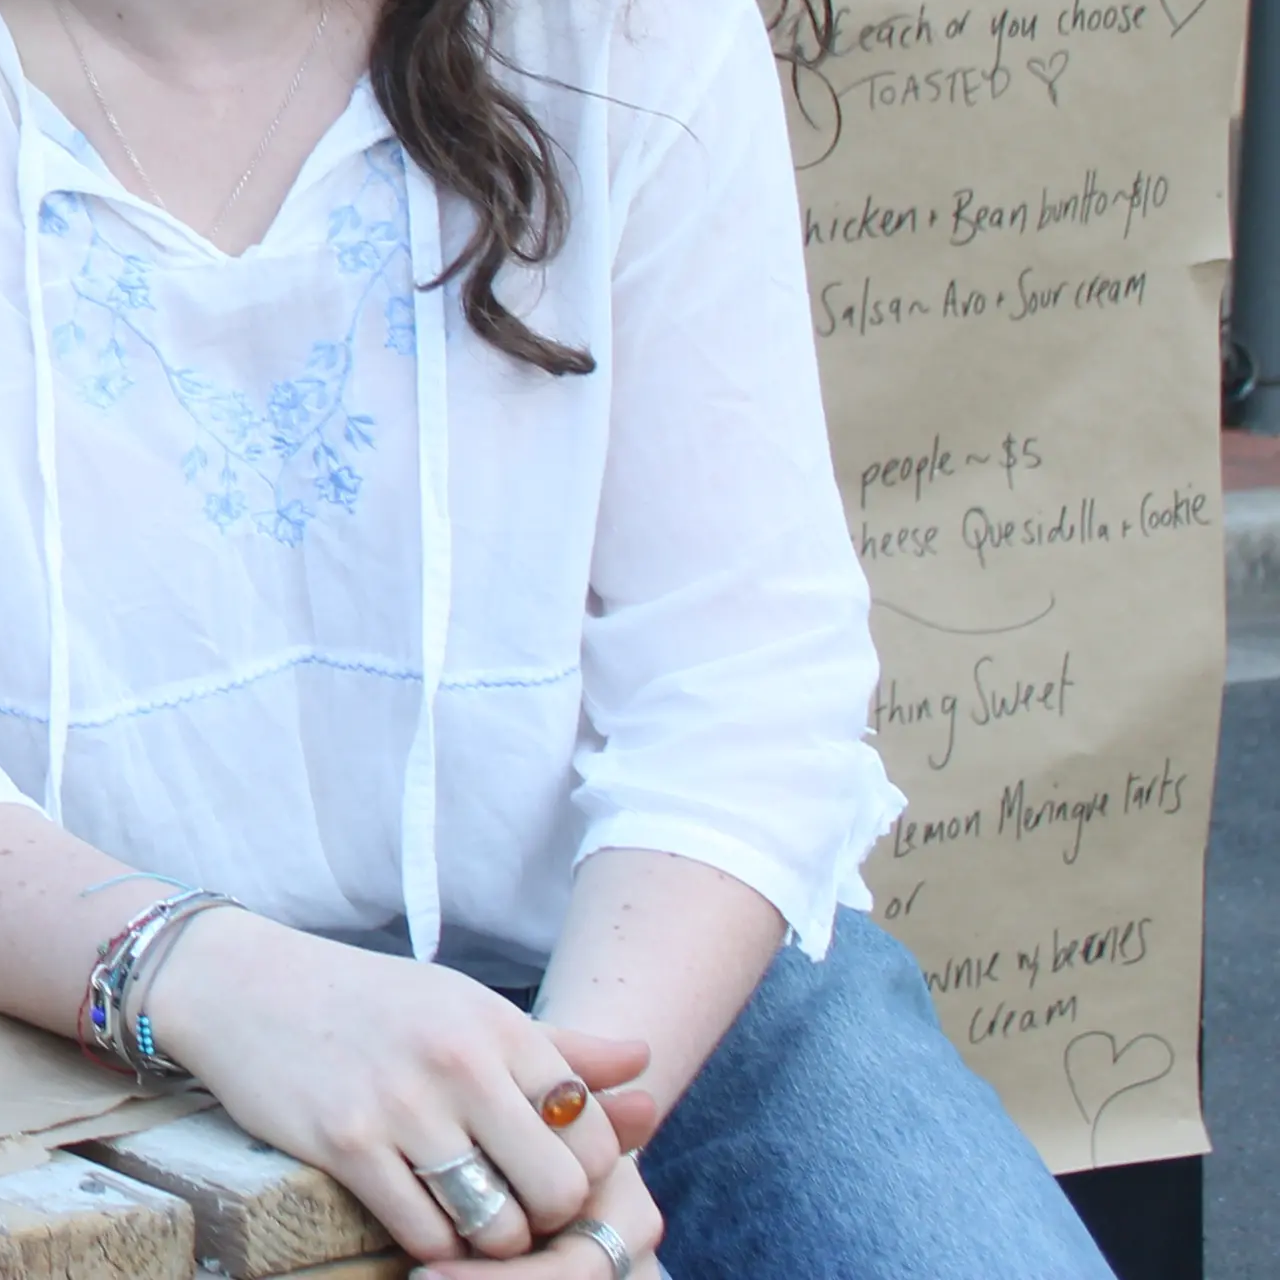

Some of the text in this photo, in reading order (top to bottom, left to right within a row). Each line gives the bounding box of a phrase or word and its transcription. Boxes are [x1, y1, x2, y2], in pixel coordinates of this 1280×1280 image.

[857, 3, 933, 52] each
[991, 8, 1038, 77] you
[838, 66, 1012, 111] TOASTED
[803, 195, 918, 248] hicken
[948, 187, 1028, 247] Bean
[816, 276, 902, 338] Salsa
[1008, 266, 1069, 322] Sour
[860, 432, 957, 511] people
[999, 431, 1042, 491] $5
[851, 520, 939, 561] heese
[970, 651, 1075, 726] Sweet
[894, 809, 982, 858] Lemon
[997, 778, 1109, 866] Meringue
